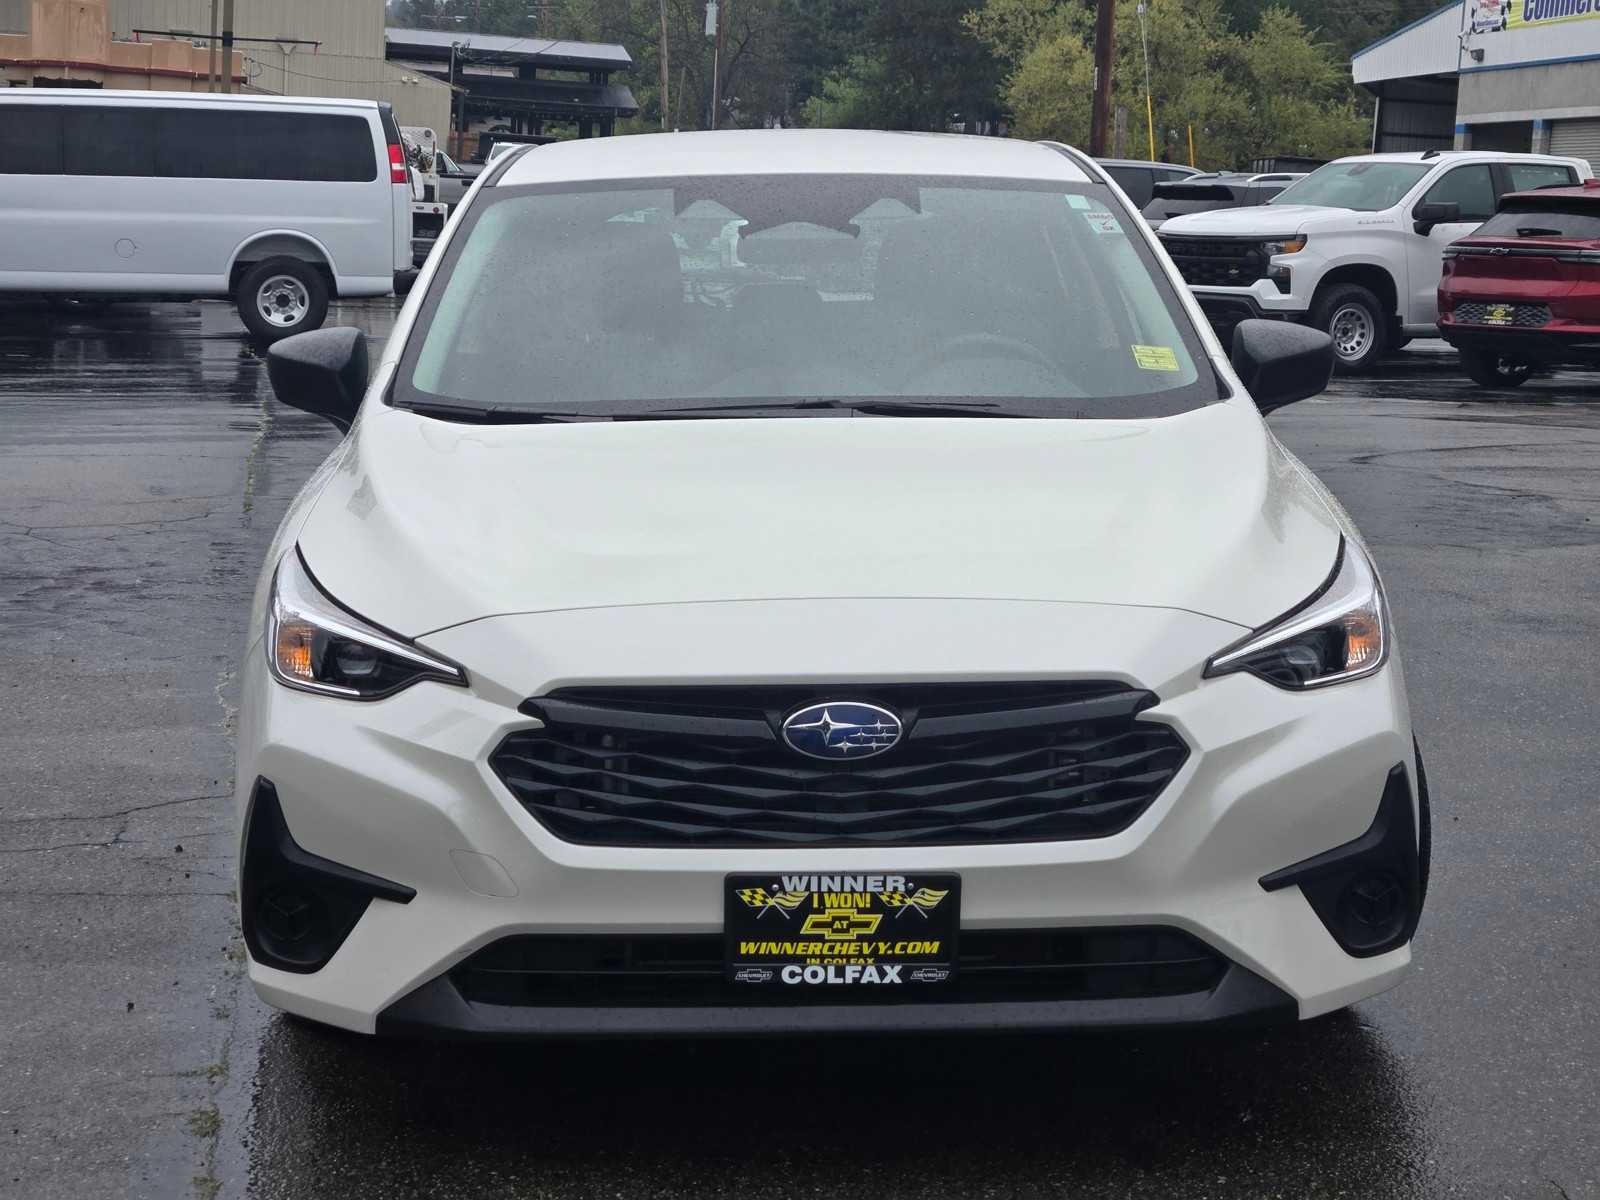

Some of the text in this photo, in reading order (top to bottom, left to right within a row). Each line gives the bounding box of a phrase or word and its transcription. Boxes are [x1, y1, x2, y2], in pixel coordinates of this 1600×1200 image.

[781, 875, 906, 892] WINNER
[812, 892, 871, 908] I WON!
[833, 920, 849, 929] AT
[739, 940, 940, 955] WINNERCHEVY.COM
[781, 964, 902, 984] COLFAX
